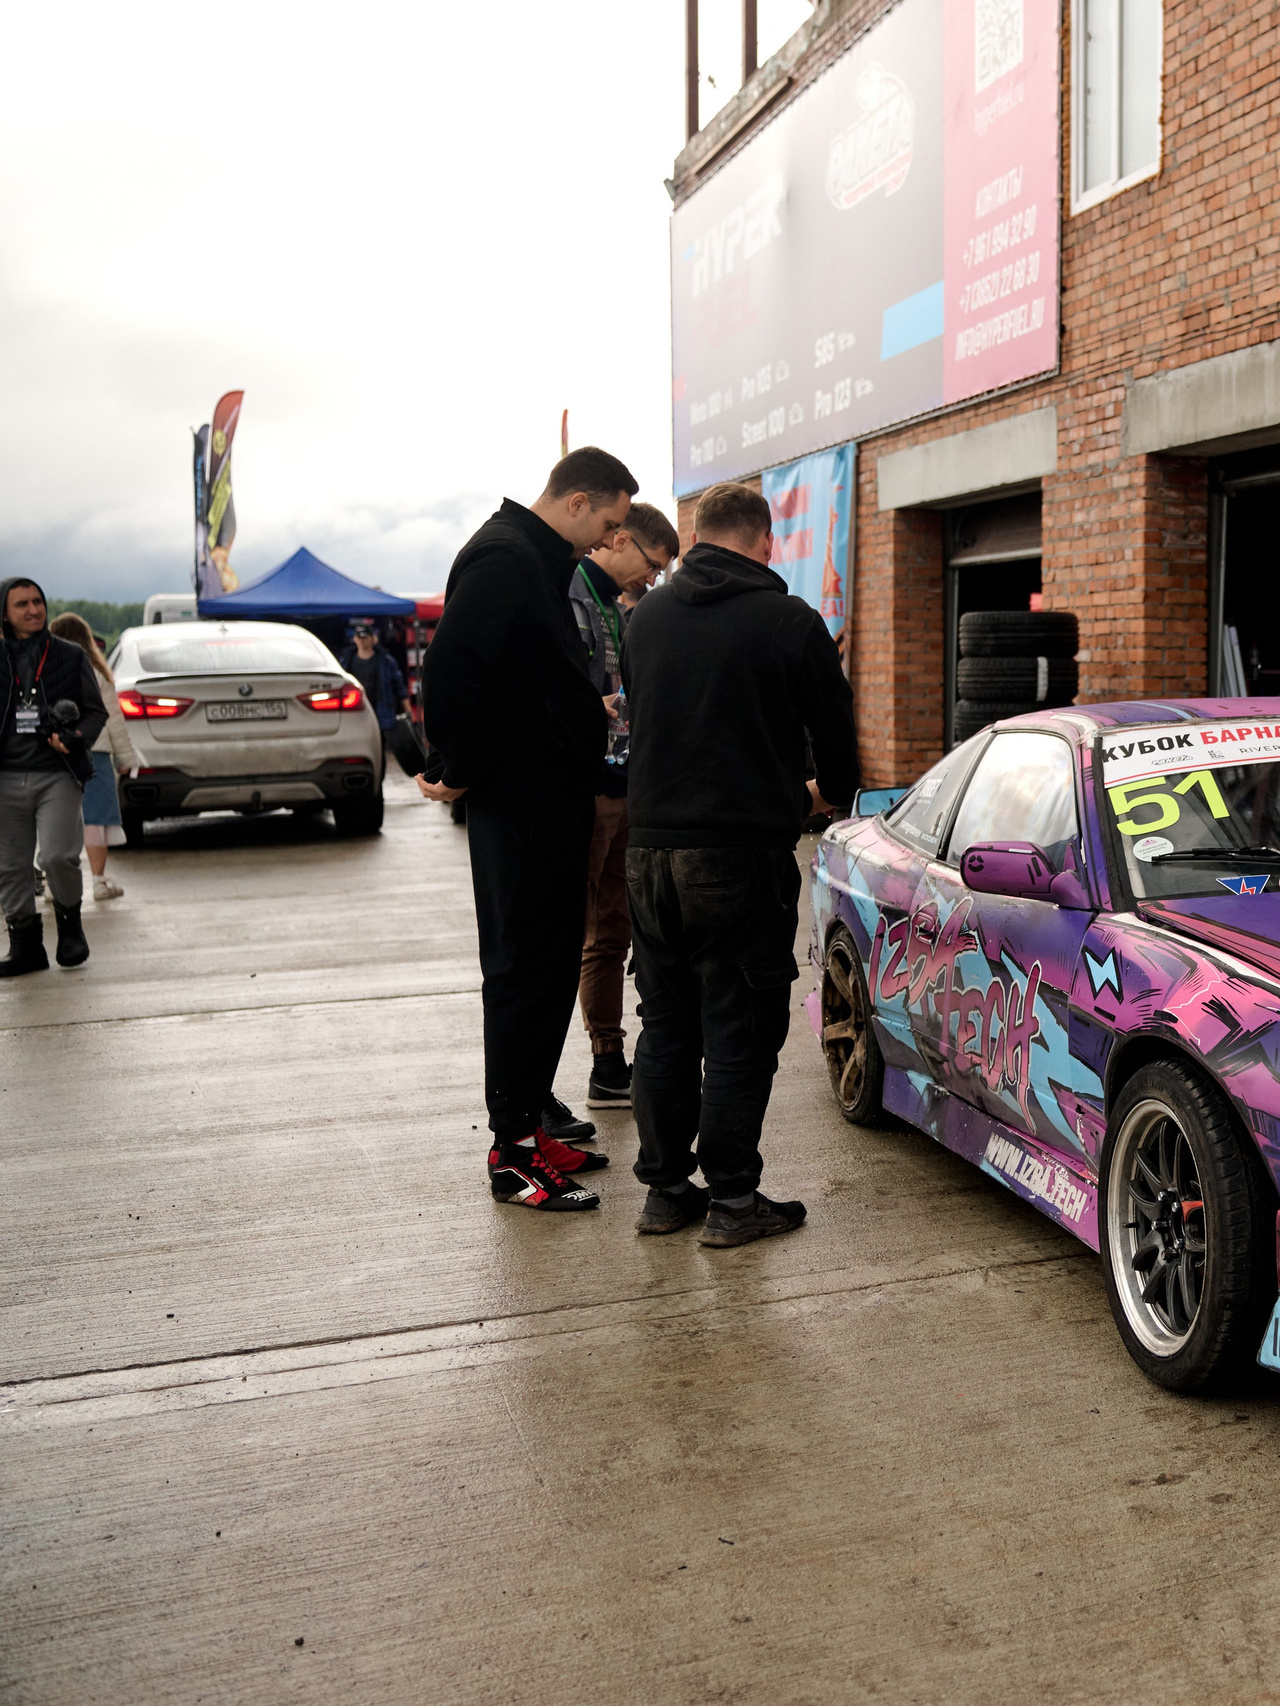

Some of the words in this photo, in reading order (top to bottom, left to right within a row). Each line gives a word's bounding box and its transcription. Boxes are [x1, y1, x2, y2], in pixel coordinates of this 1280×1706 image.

[975, 164, 1023, 220] КОНТАКТЫ
[690, 170, 783, 298] HYPER
[955, 296, 1045, 362] INFO@HYPERFUEL.RU
[741, 417, 766, 449] Street
[814, 389, 832, 421] Pro
[1103, 733, 1194, 763] КУБОК
[1108, 770, 1230, 836] 51
[869, 896, 978, 1009] IZBA
[934, 960, 1040, 1135] TECH
[984, 1131, 1088, 1223] WWW.IZBA.TECH
